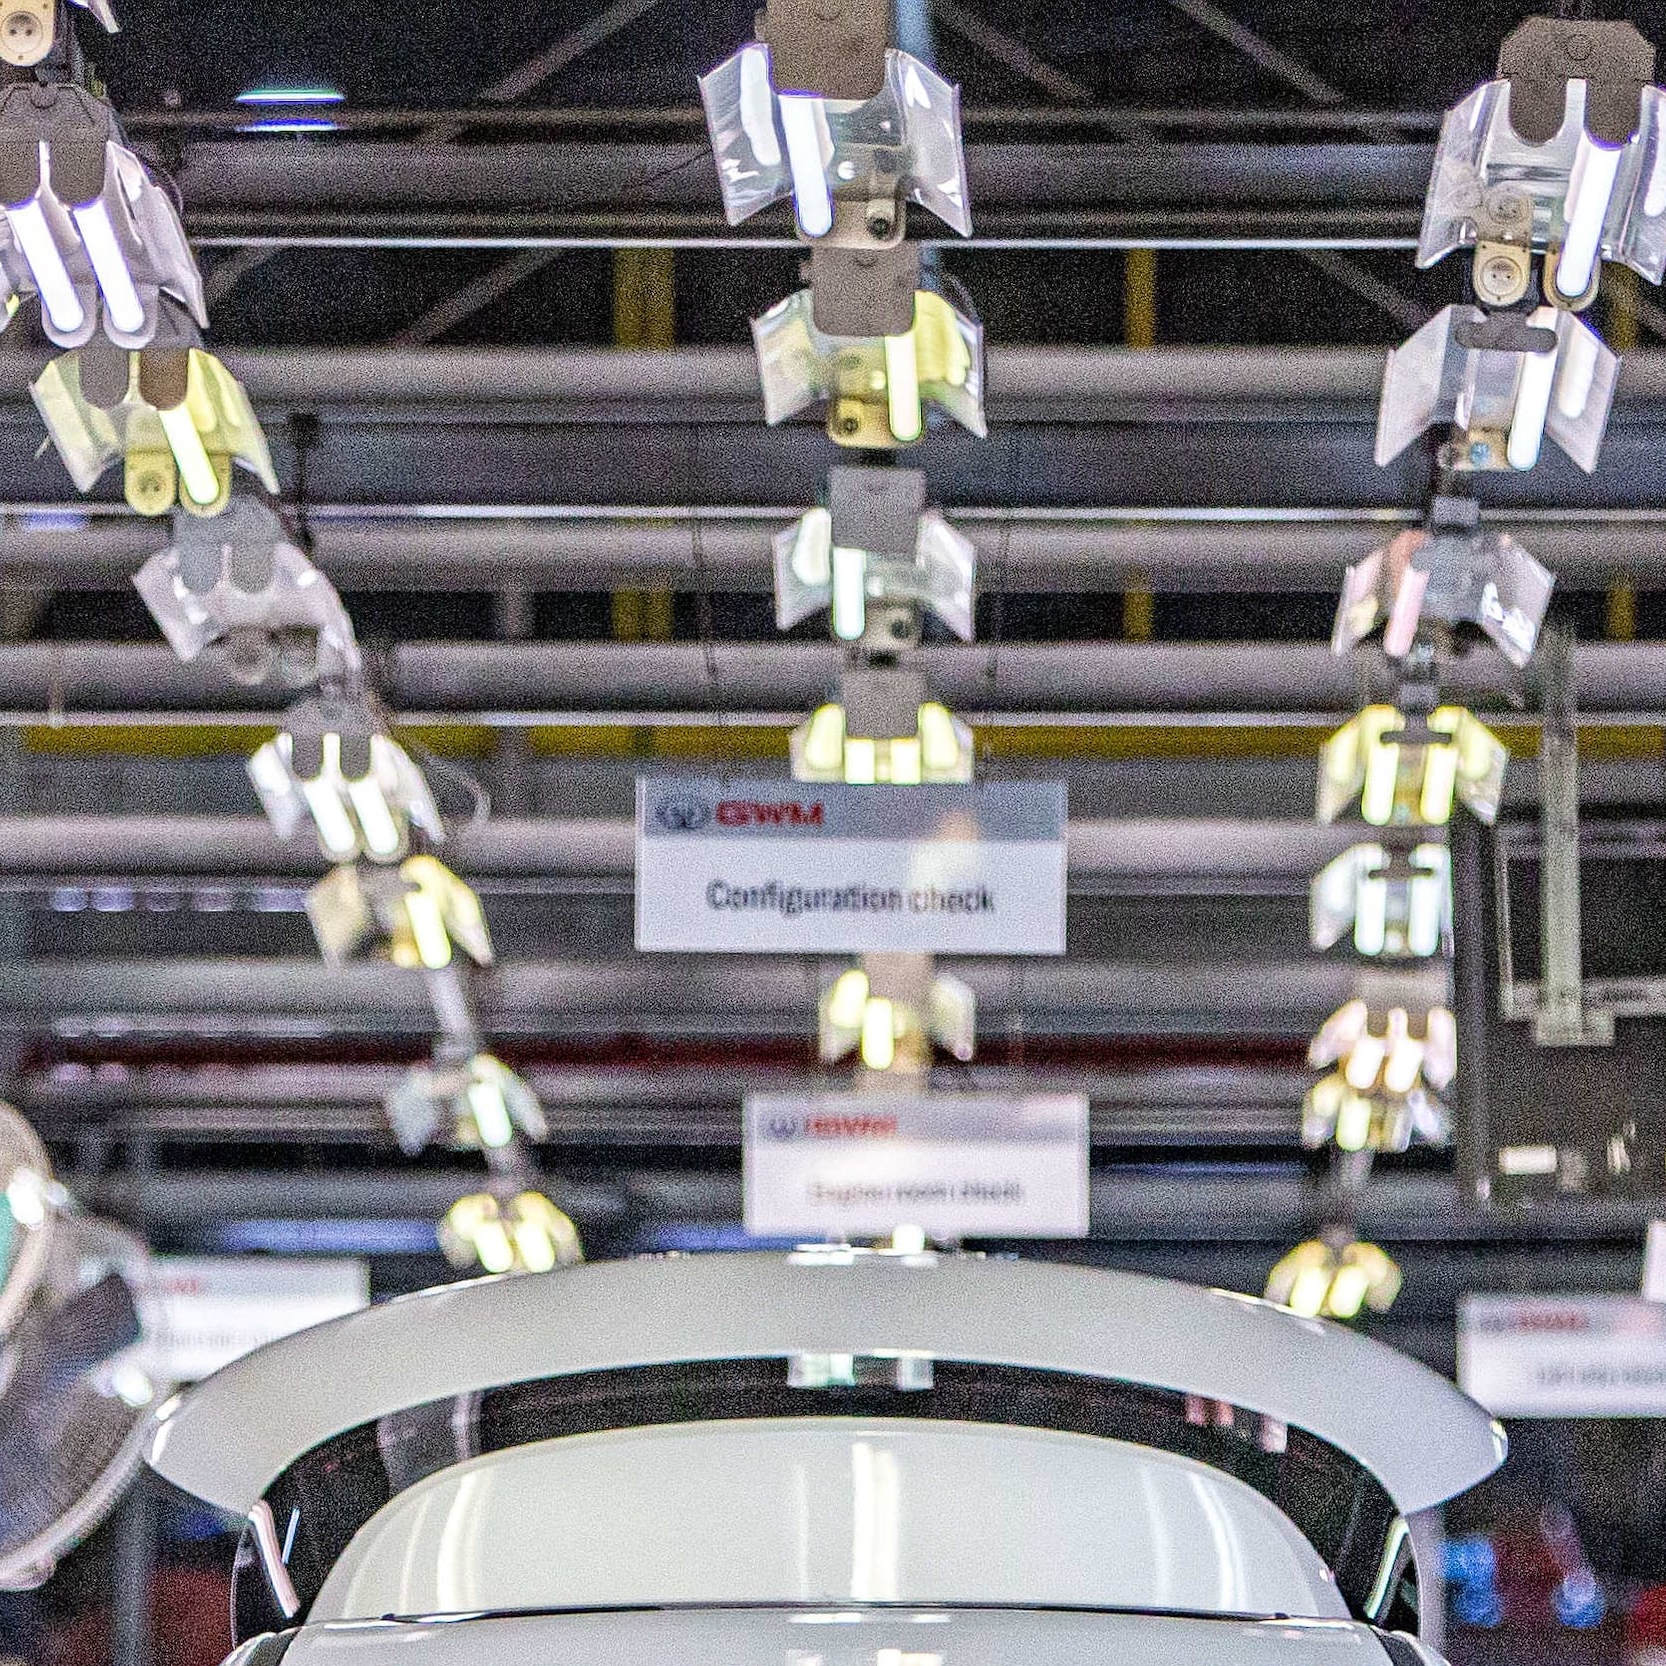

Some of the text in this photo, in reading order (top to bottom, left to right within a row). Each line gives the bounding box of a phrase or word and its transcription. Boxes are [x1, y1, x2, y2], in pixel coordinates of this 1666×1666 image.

[715, 799, 825, 826] GWM
[706, 879, 995, 917] Configuration check
